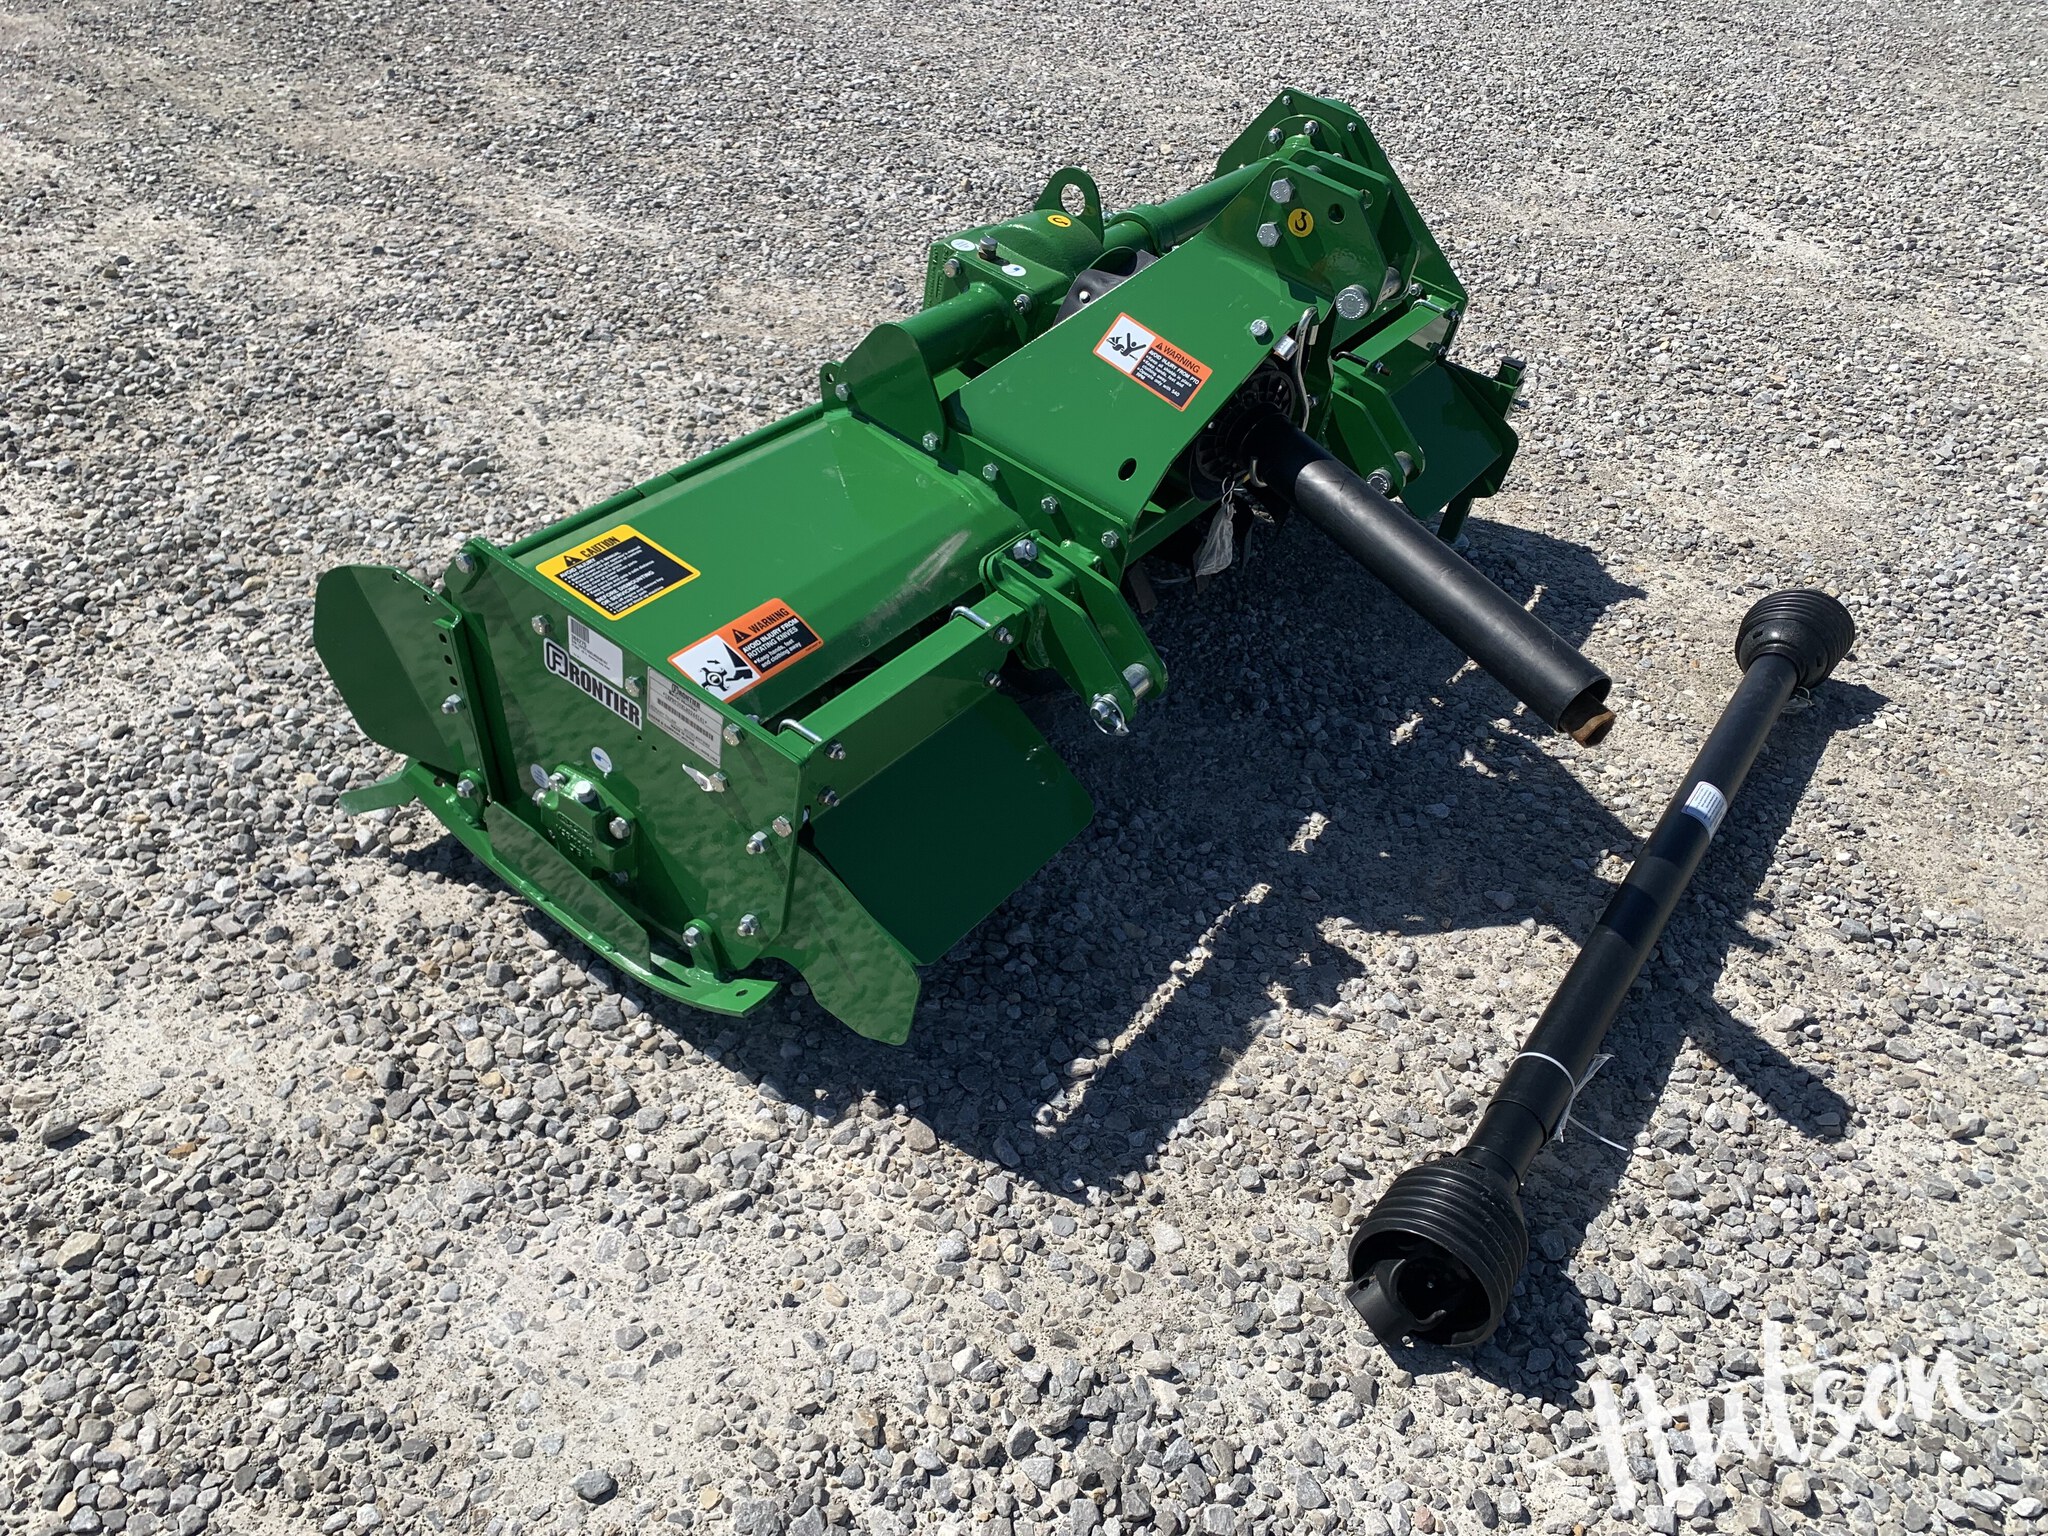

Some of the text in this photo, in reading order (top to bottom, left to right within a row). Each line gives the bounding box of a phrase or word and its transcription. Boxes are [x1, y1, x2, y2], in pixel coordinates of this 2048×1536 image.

[1149, 350, 1200, 384] AVOID INJURY FROM PTO
[1164, 346, 1200, 373] WARNING
[580, 536, 620, 557] CAUTION
[748, 608, 789, 633] WARNING
[742, 618, 798, 653] AVOID INJURY FROM
[748, 626, 798, 658] ROTATING KNIVES
[757, 653, 770, 664] Keep
[784, 639, 794, 647] feet
[771, 649, 789, 663] clothing
[789, 642, 802, 652] away
[546, 641, 640, 726] FRONTIER
